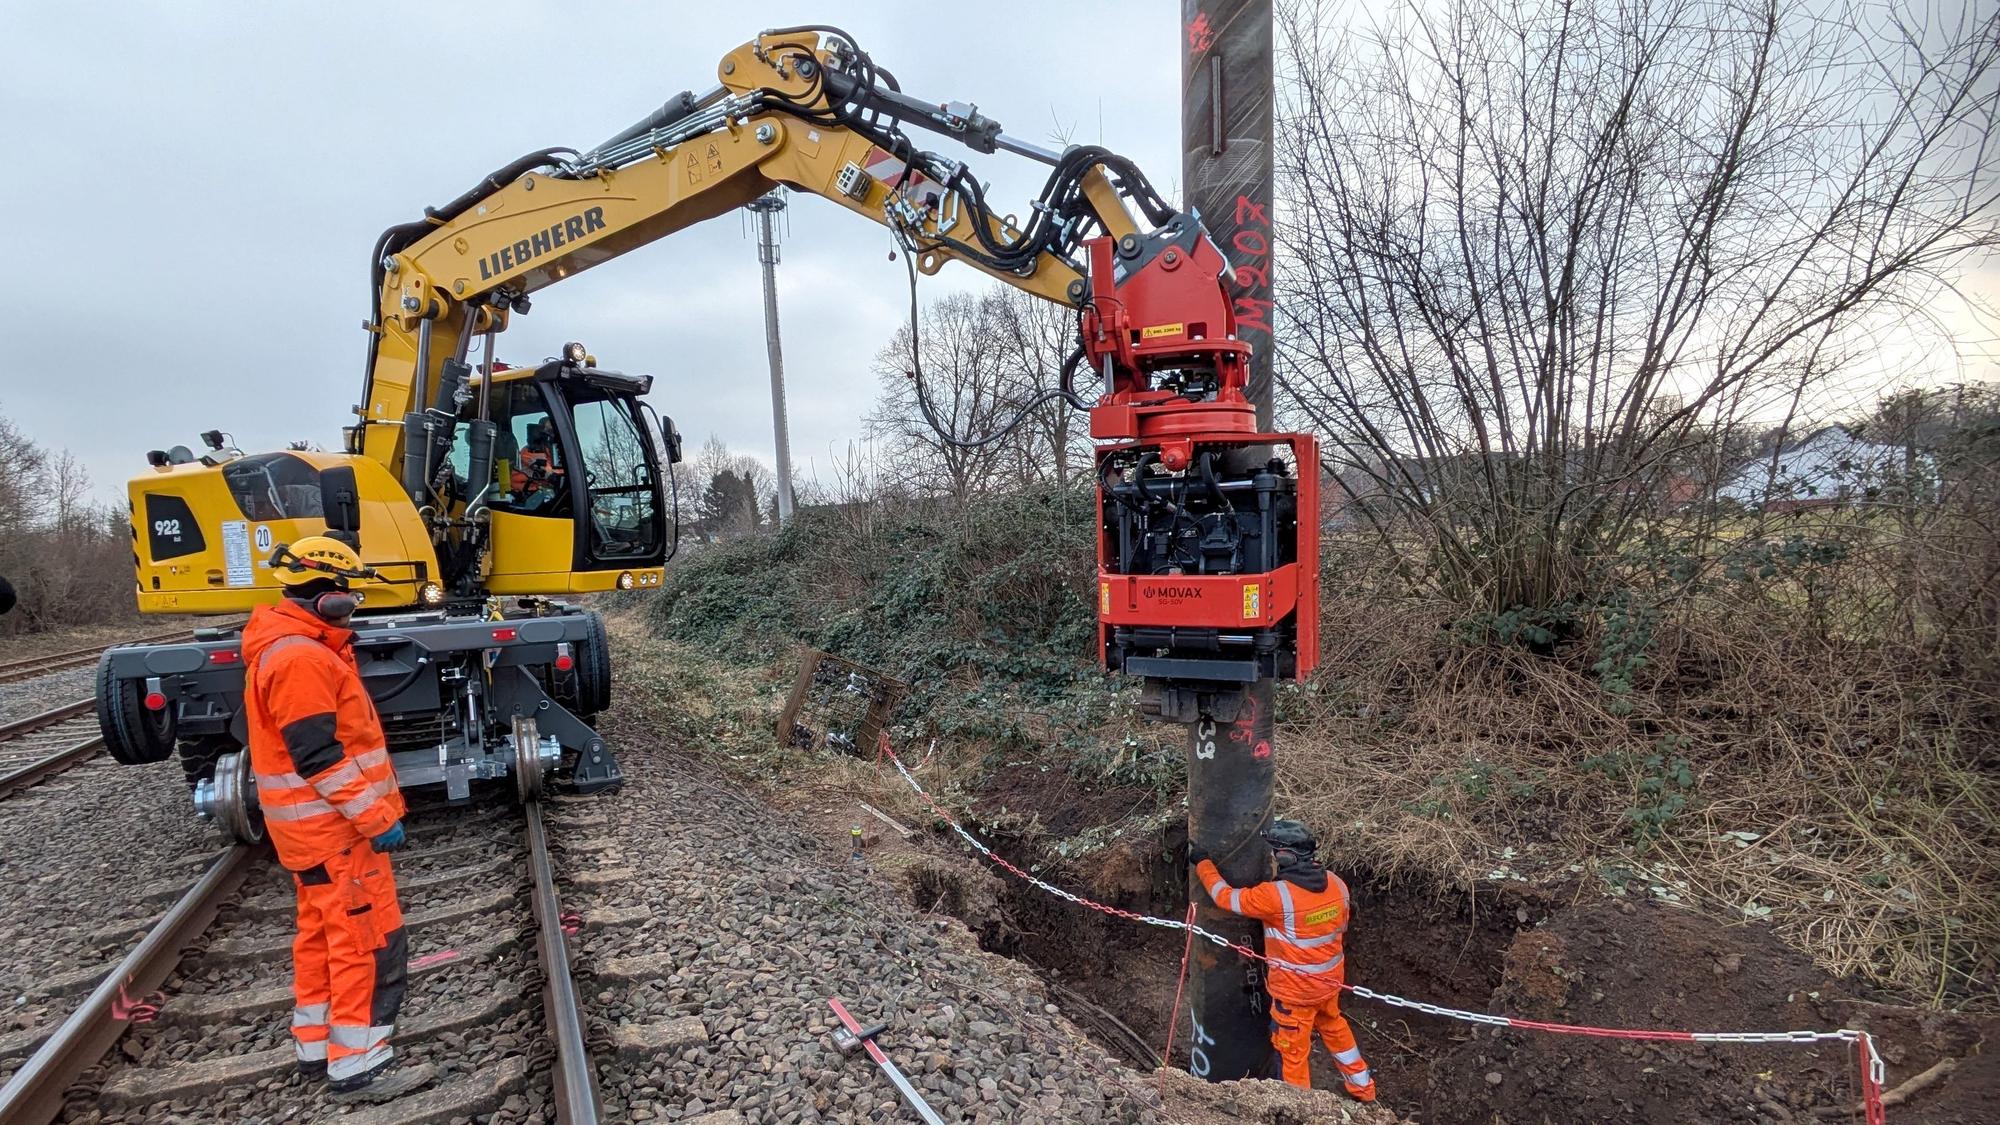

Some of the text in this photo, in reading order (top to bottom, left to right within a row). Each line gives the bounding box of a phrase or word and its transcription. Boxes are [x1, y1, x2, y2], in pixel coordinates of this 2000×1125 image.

[479, 206, 606, 281] LIEBHERR
[1233, 195, 1274, 335] M207
[155, 519, 180, 535] 922
[257, 529, 269, 546] 20
[1158, 587, 1202, 599] MOVAX
